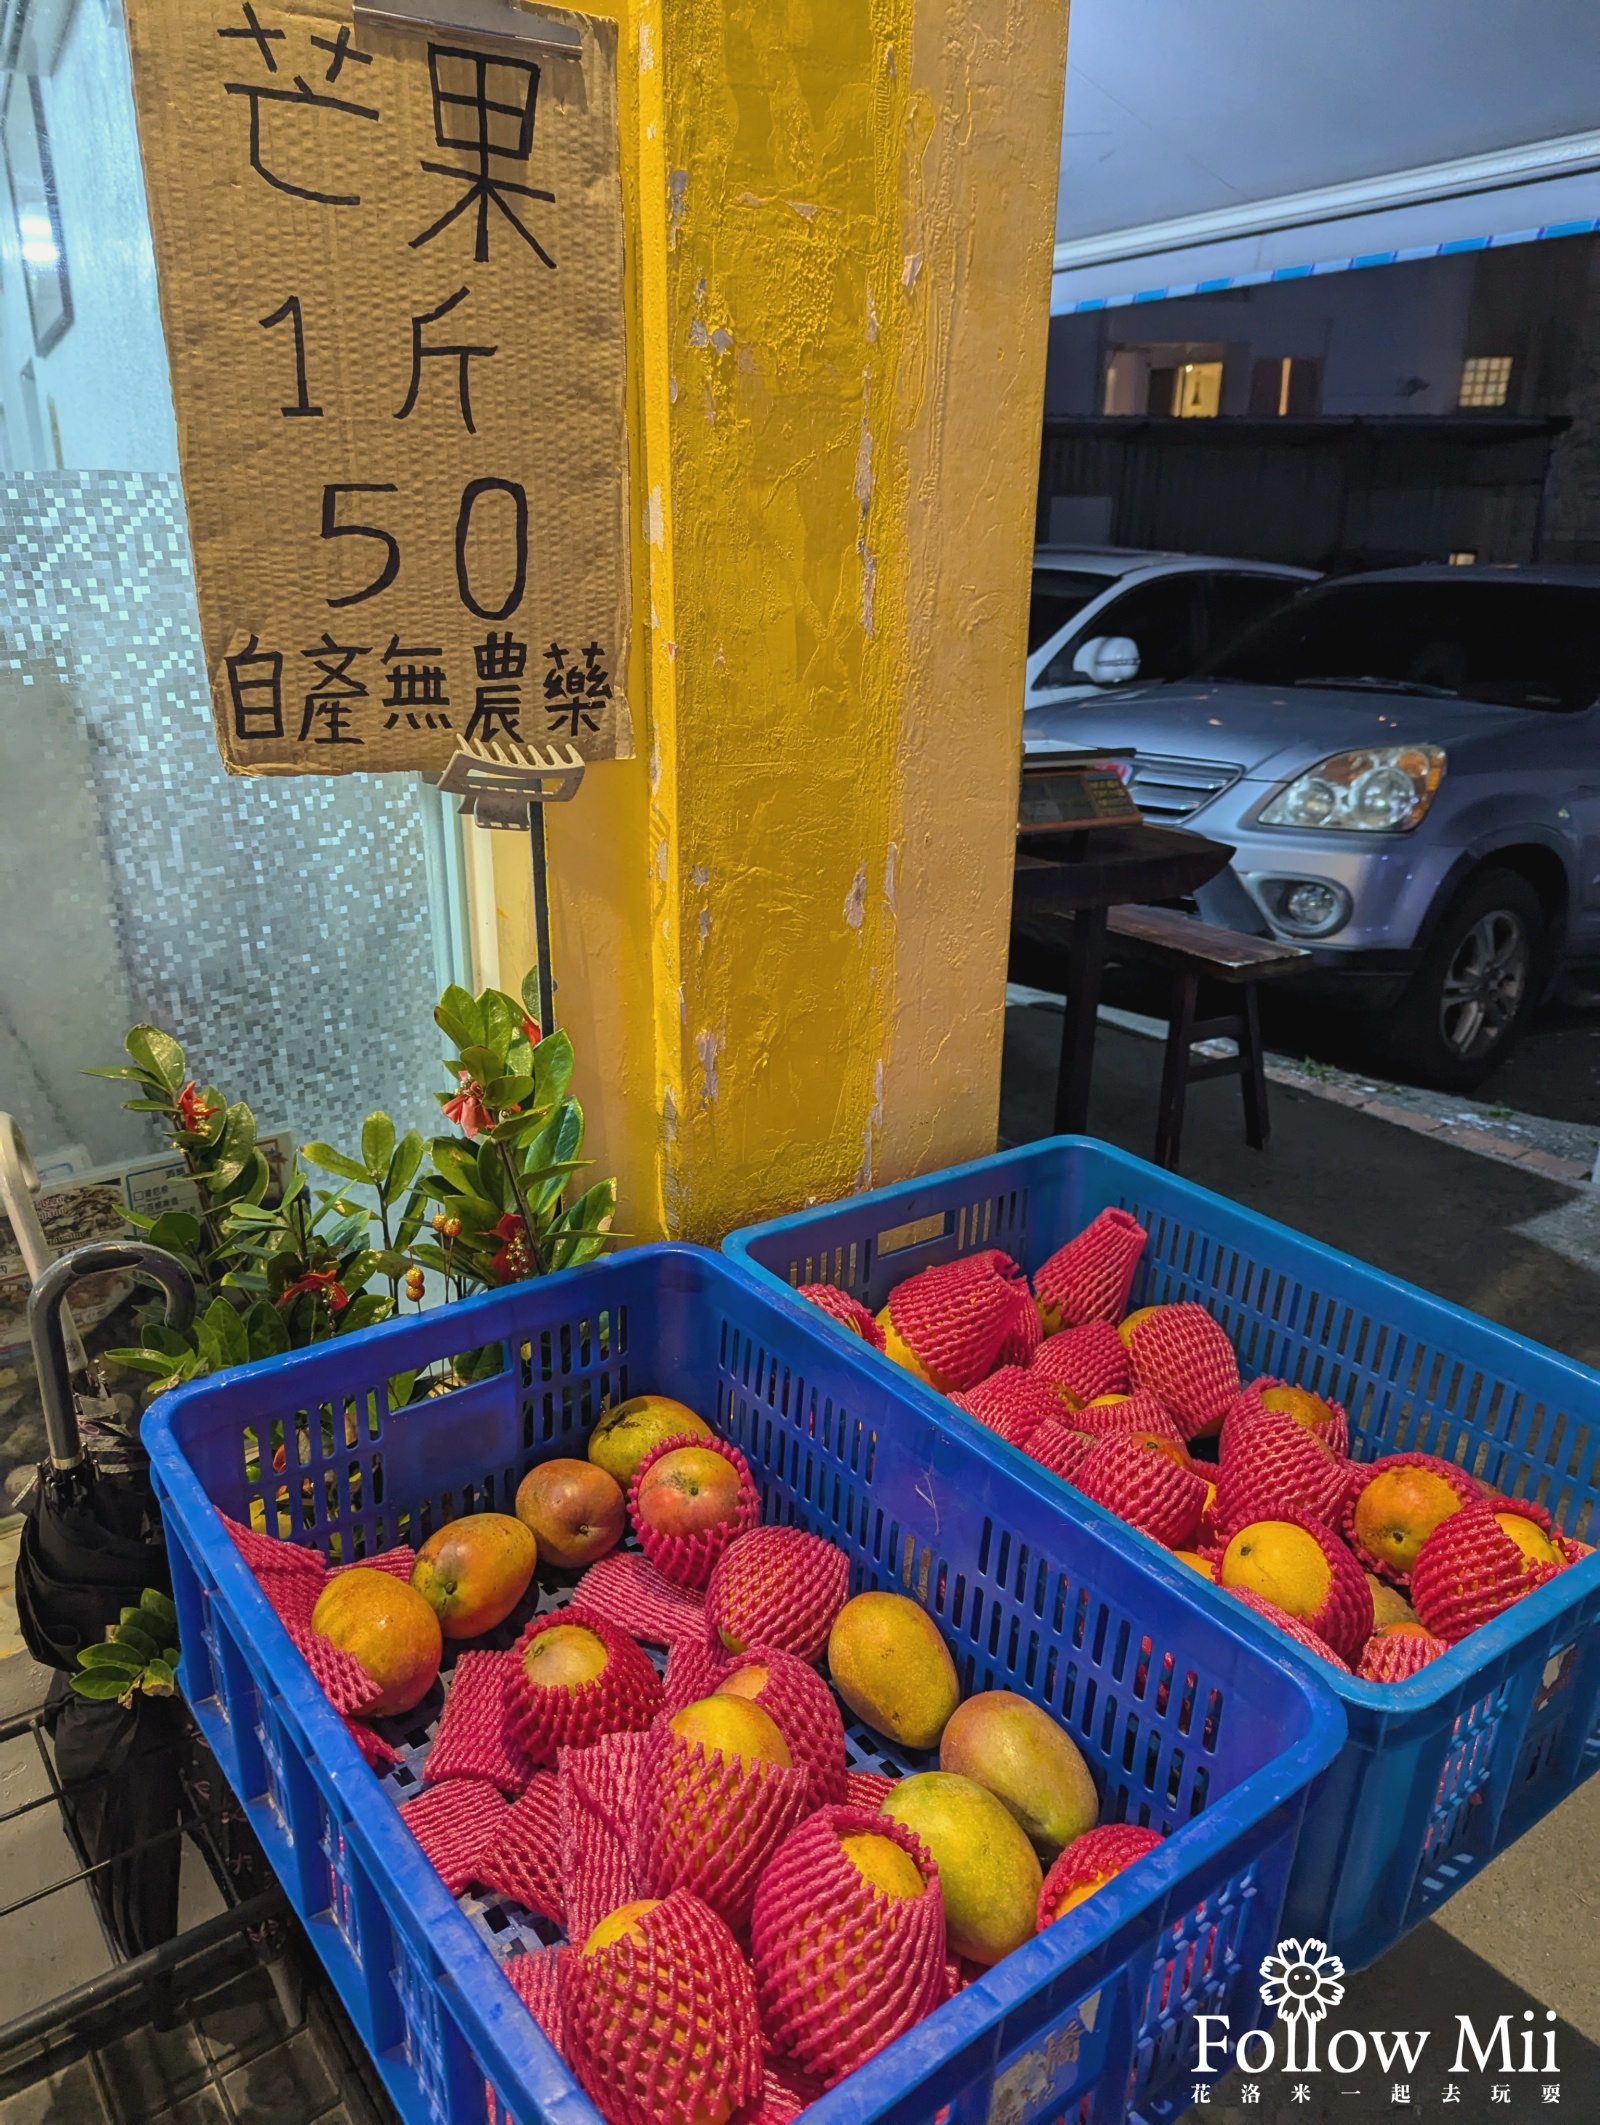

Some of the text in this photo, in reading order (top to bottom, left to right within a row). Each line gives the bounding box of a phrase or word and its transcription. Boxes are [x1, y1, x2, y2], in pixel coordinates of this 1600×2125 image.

[217, 3, 557, 270] 芒果
[320, 477, 529, 620] 50
[224, 632, 614, 744] 自產無農藥
